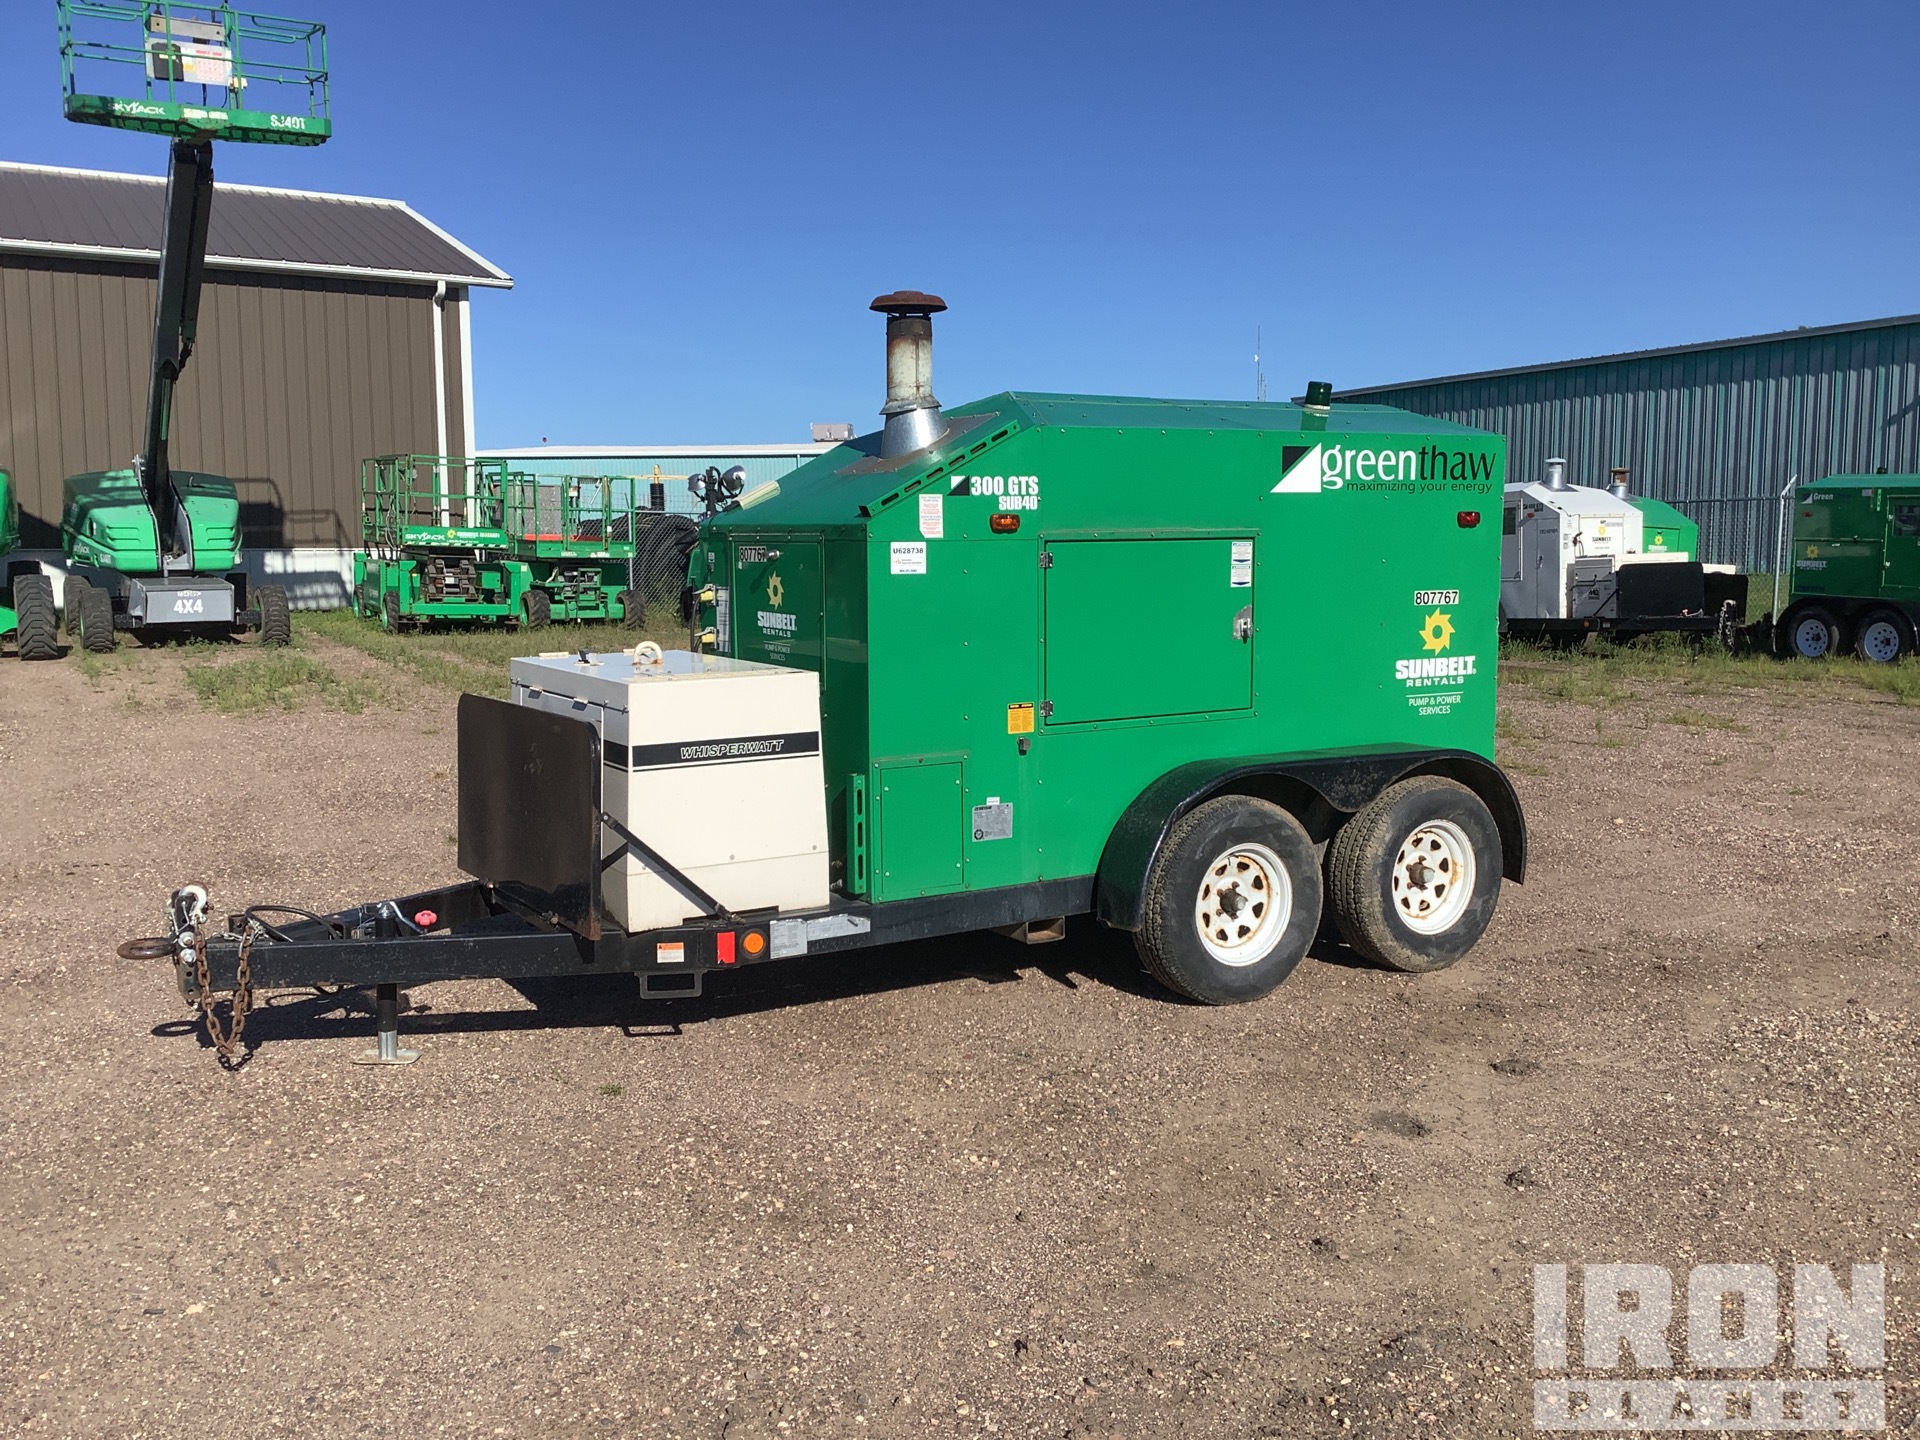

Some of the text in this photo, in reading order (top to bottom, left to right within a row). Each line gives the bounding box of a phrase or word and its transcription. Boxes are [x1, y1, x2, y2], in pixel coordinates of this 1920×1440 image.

[108, 101, 165, 115] SKYJACK
[970, 475, 1039, 496] 300 GTS
[1346, 481, 1493, 494] maximizing your energy
[1813, 492, 1834, 500] Green
[998, 495, 1038, 511] SUB40
[404, 531, 446, 541] SKYJACK
[739, 547, 767, 562] 807767
[892, 547, 924, 555] U628738
[1415, 591, 1458, 605] 807767
[173, 598, 204, 614] 4X4
[757, 611, 797, 632] SUNBELT
[762, 627, 792, 638] RENTALS
[764, 643, 775, 652] PUMP
[777, 645, 791, 654] POWER
[1395, 655, 1476, 680] SUNBELT
[1405, 676, 1465, 688] RENTALS
[1408, 695, 1461, 707] PUMP & POWER
[1418, 705, 1451, 716] SERVICES
[681, 739, 785, 760] WHISPERWATT
